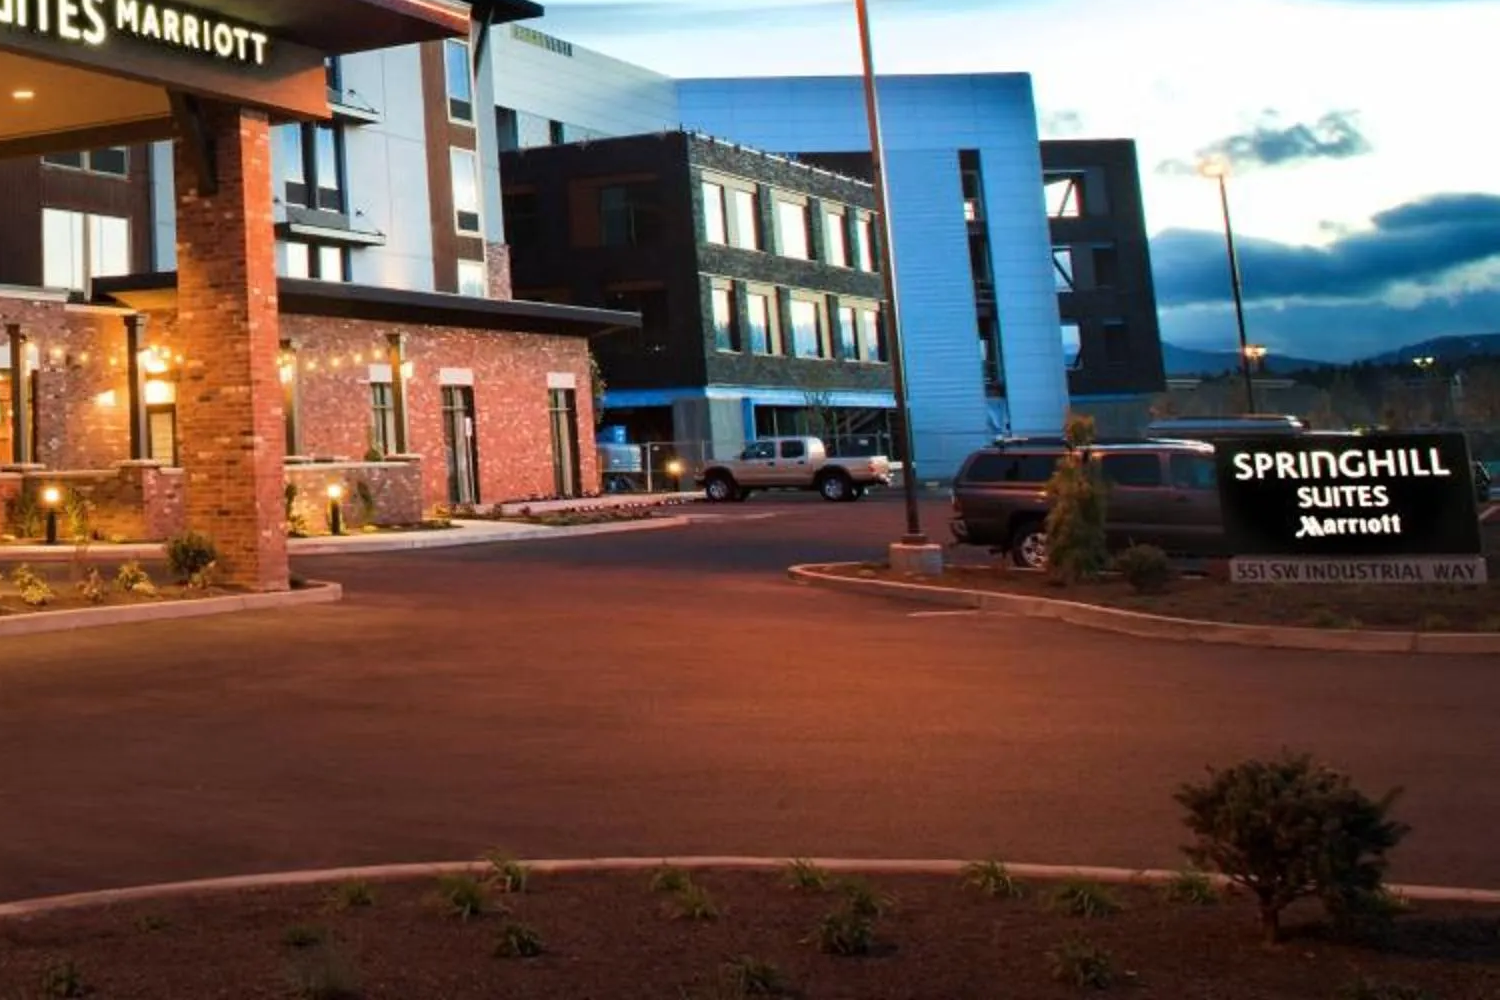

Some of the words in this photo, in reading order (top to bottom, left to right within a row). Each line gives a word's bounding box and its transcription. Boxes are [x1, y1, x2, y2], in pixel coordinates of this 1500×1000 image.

[1233, 447, 1451, 480] SPRINGHILL
[1297, 485, 1389, 508] SUITES
[1295, 513, 1401, 538] Marriott
[1237, 563, 1265, 579] 551
[1269, 563, 1299, 579] SW
[1305, 563, 1422, 579] INDUSTRIAL
[1433, 563, 1476, 579] WAY
